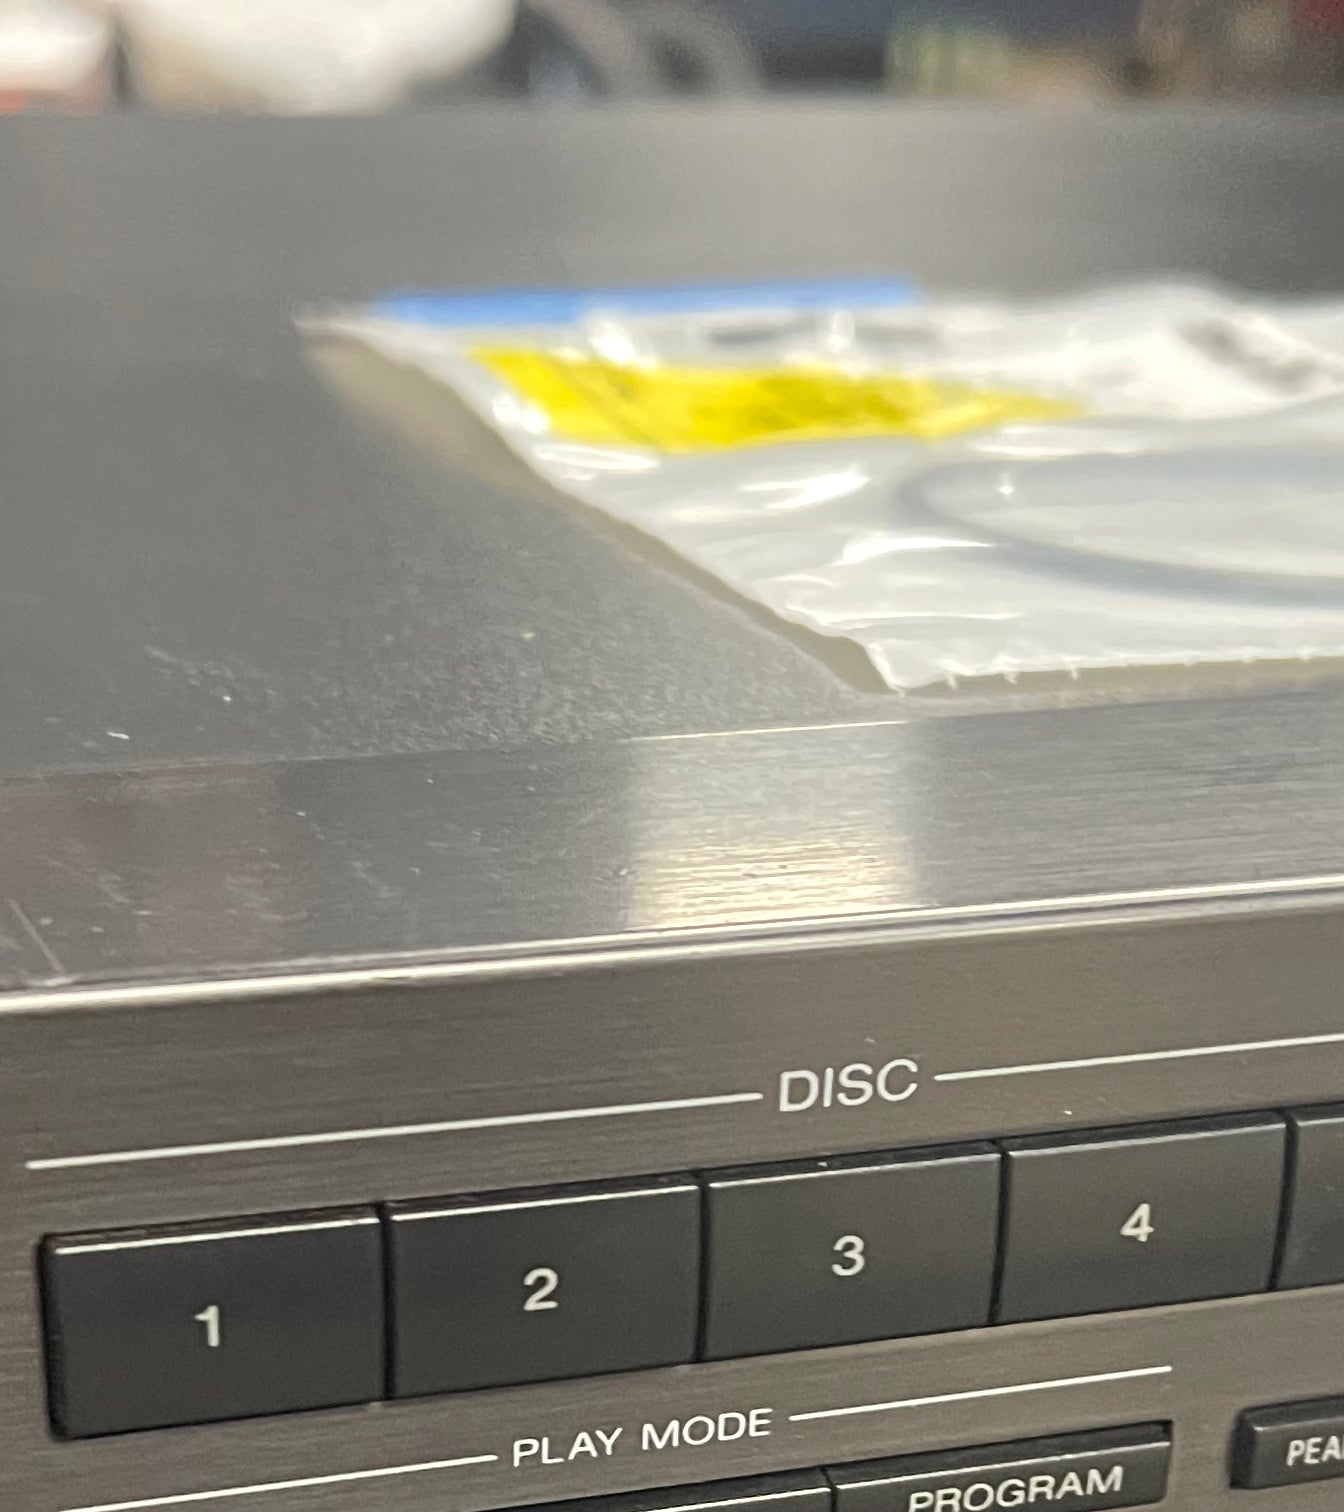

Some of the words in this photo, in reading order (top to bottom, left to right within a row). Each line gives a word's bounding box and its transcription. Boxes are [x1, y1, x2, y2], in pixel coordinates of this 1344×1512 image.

[778, 1057, 919, 1112] DISC
[1120, 1202, 1155, 1243] 4
[831, 1234, 866, 1277] 3
[523, 1267, 559, 1312] 2
[194, 1304, 220, 1348] 1
[512, 1426, 622, 1468] PLAY
[641, 1407, 774, 1452] MODE
